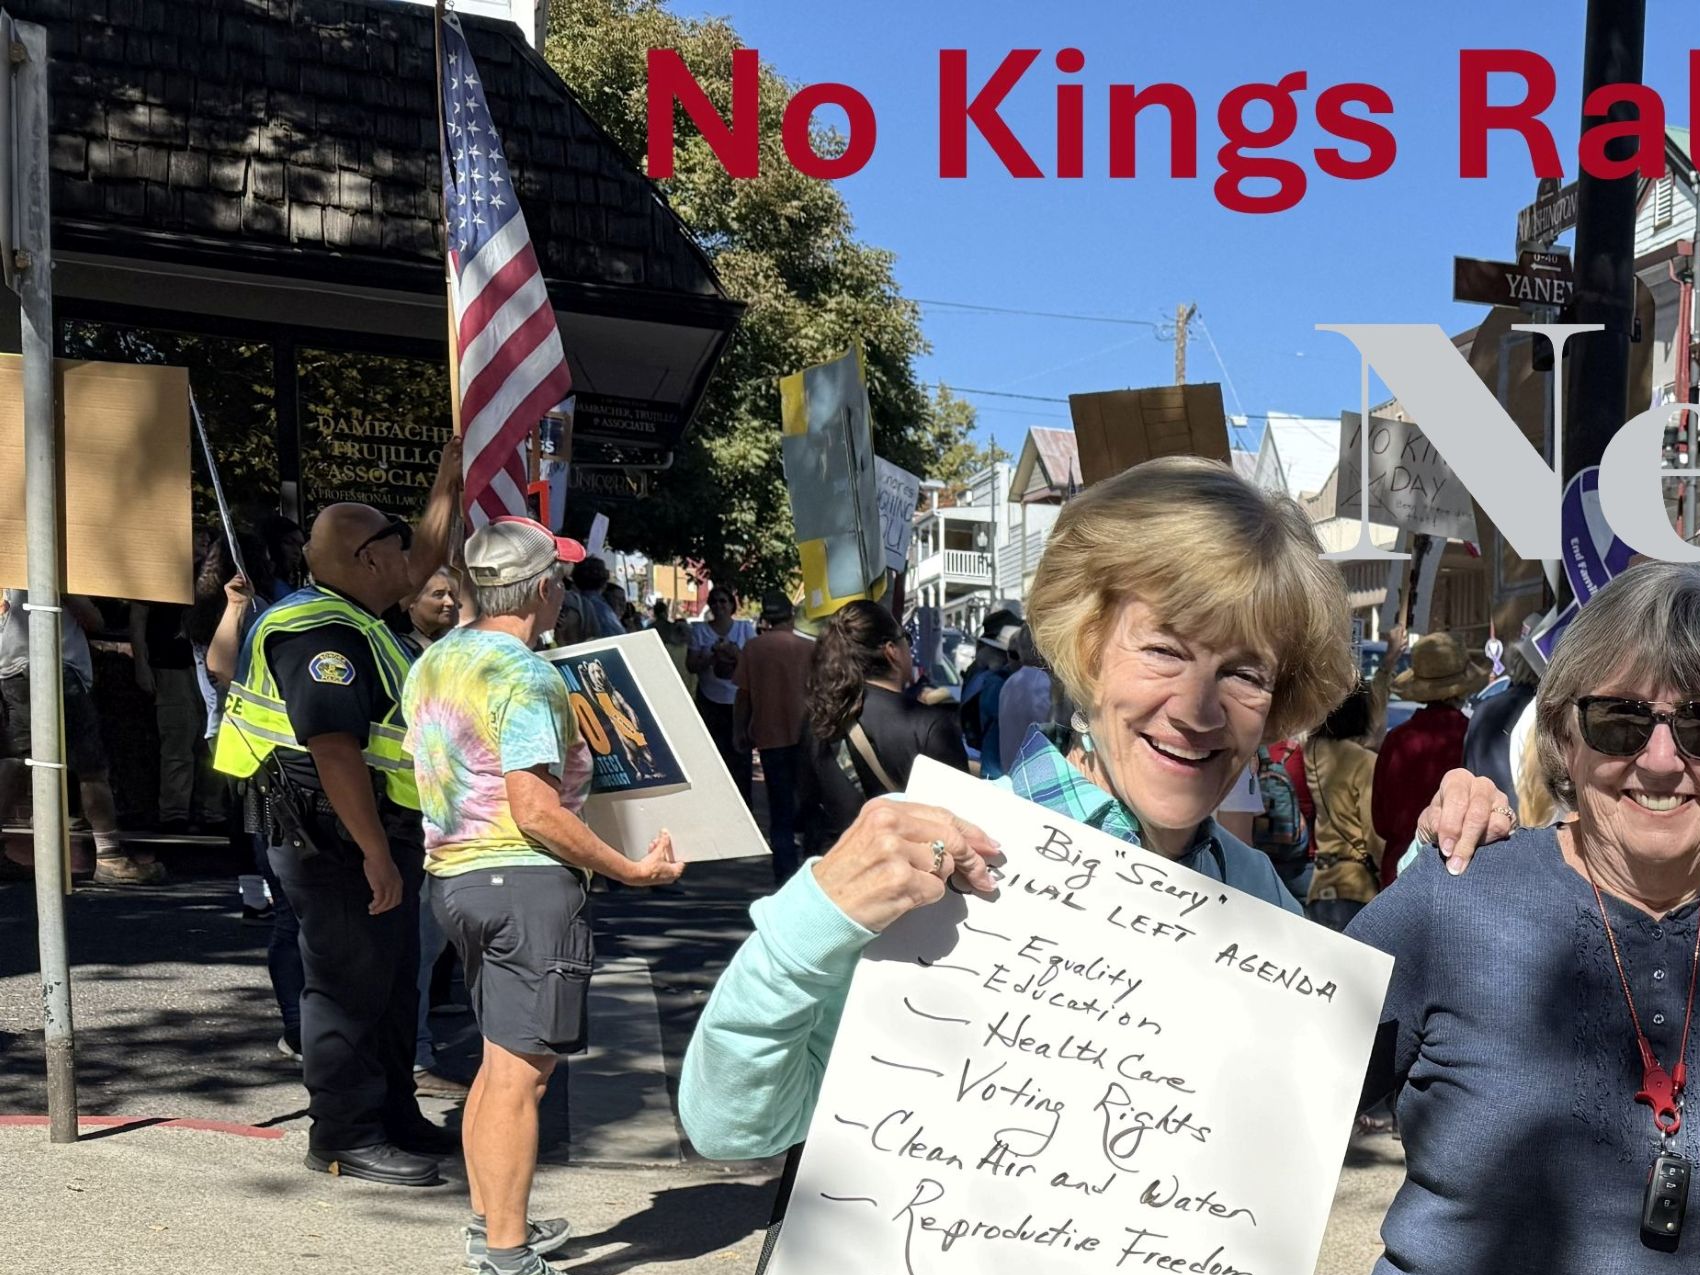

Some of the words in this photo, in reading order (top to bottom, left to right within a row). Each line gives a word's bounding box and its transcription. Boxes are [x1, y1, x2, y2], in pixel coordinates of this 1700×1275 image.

[1505, 273, 1574, 304] YANE
[1390, 466, 1446, 502] DAY
[1035, 824, 1101, 890] Big
[1018, 934, 1143, 1005] Equality
[1107, 904, 1197, 943] LEFT
[1215, 943, 1338, 1003] AGENDA
[983, 964, 1163, 1035] Education
[983, 1011, 1105, 1071] Health
[1116, 1054, 1197, 1094] Care
[956, 1058, 1065, 1158] Voting
[1093, 1082, 1212, 1174] Rights
[871, 1109, 963, 1170] Clean
[976, 1140, 1037, 1178] Air
[1050, 1173, 1116, 1197] and
[1139, 1174, 1257, 1226] Water
